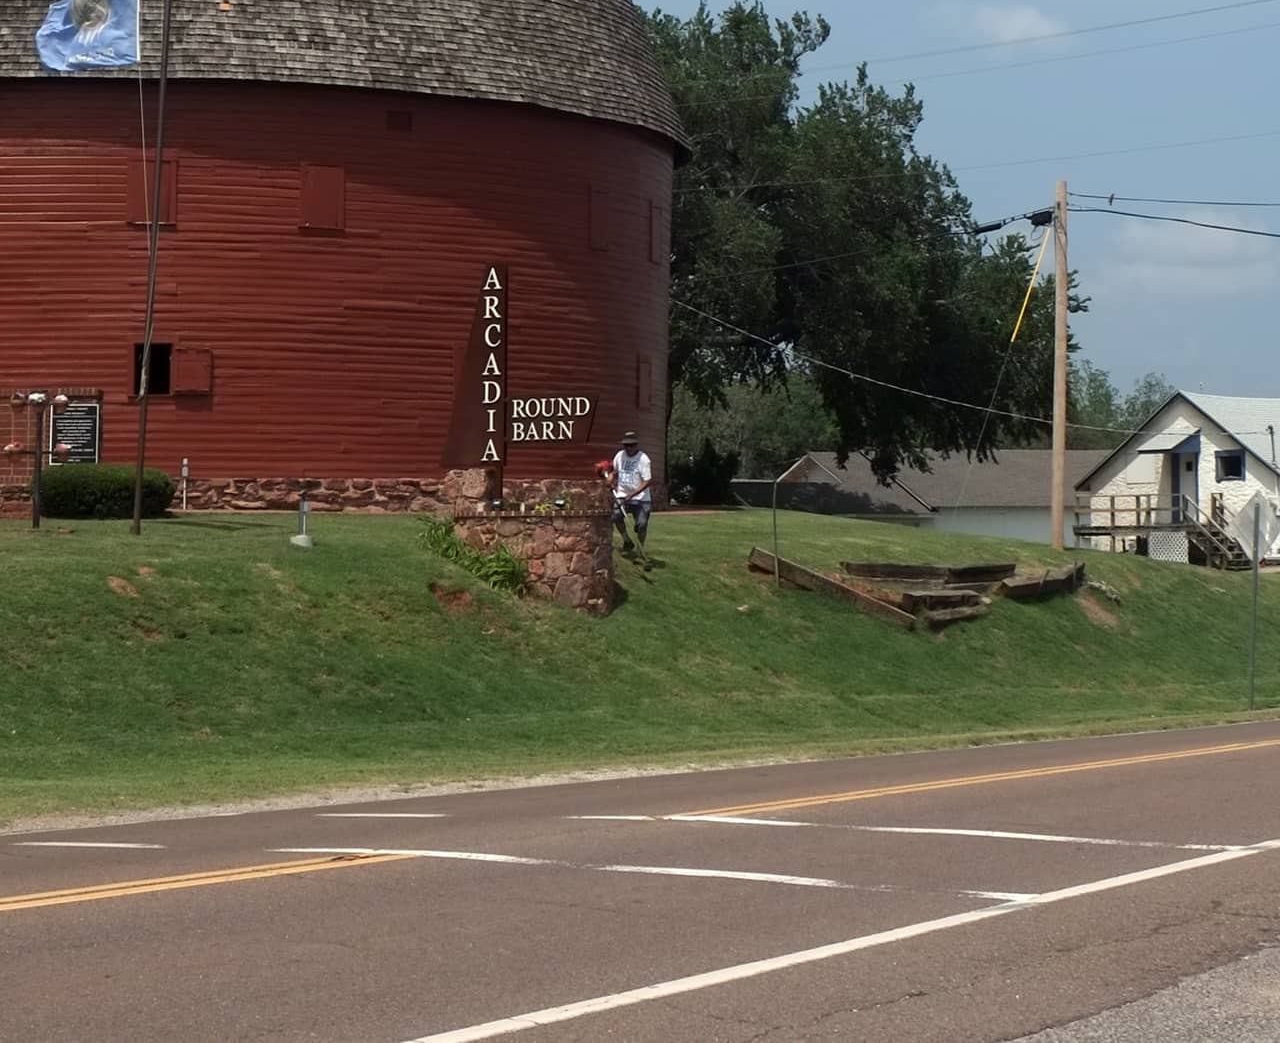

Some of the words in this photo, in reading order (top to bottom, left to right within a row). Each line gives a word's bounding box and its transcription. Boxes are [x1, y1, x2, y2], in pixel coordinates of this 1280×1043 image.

[481, 267, 503, 461] ARCADIA
[511, 397, 590, 418] ROUND
[511, 420, 574, 441] BARN
